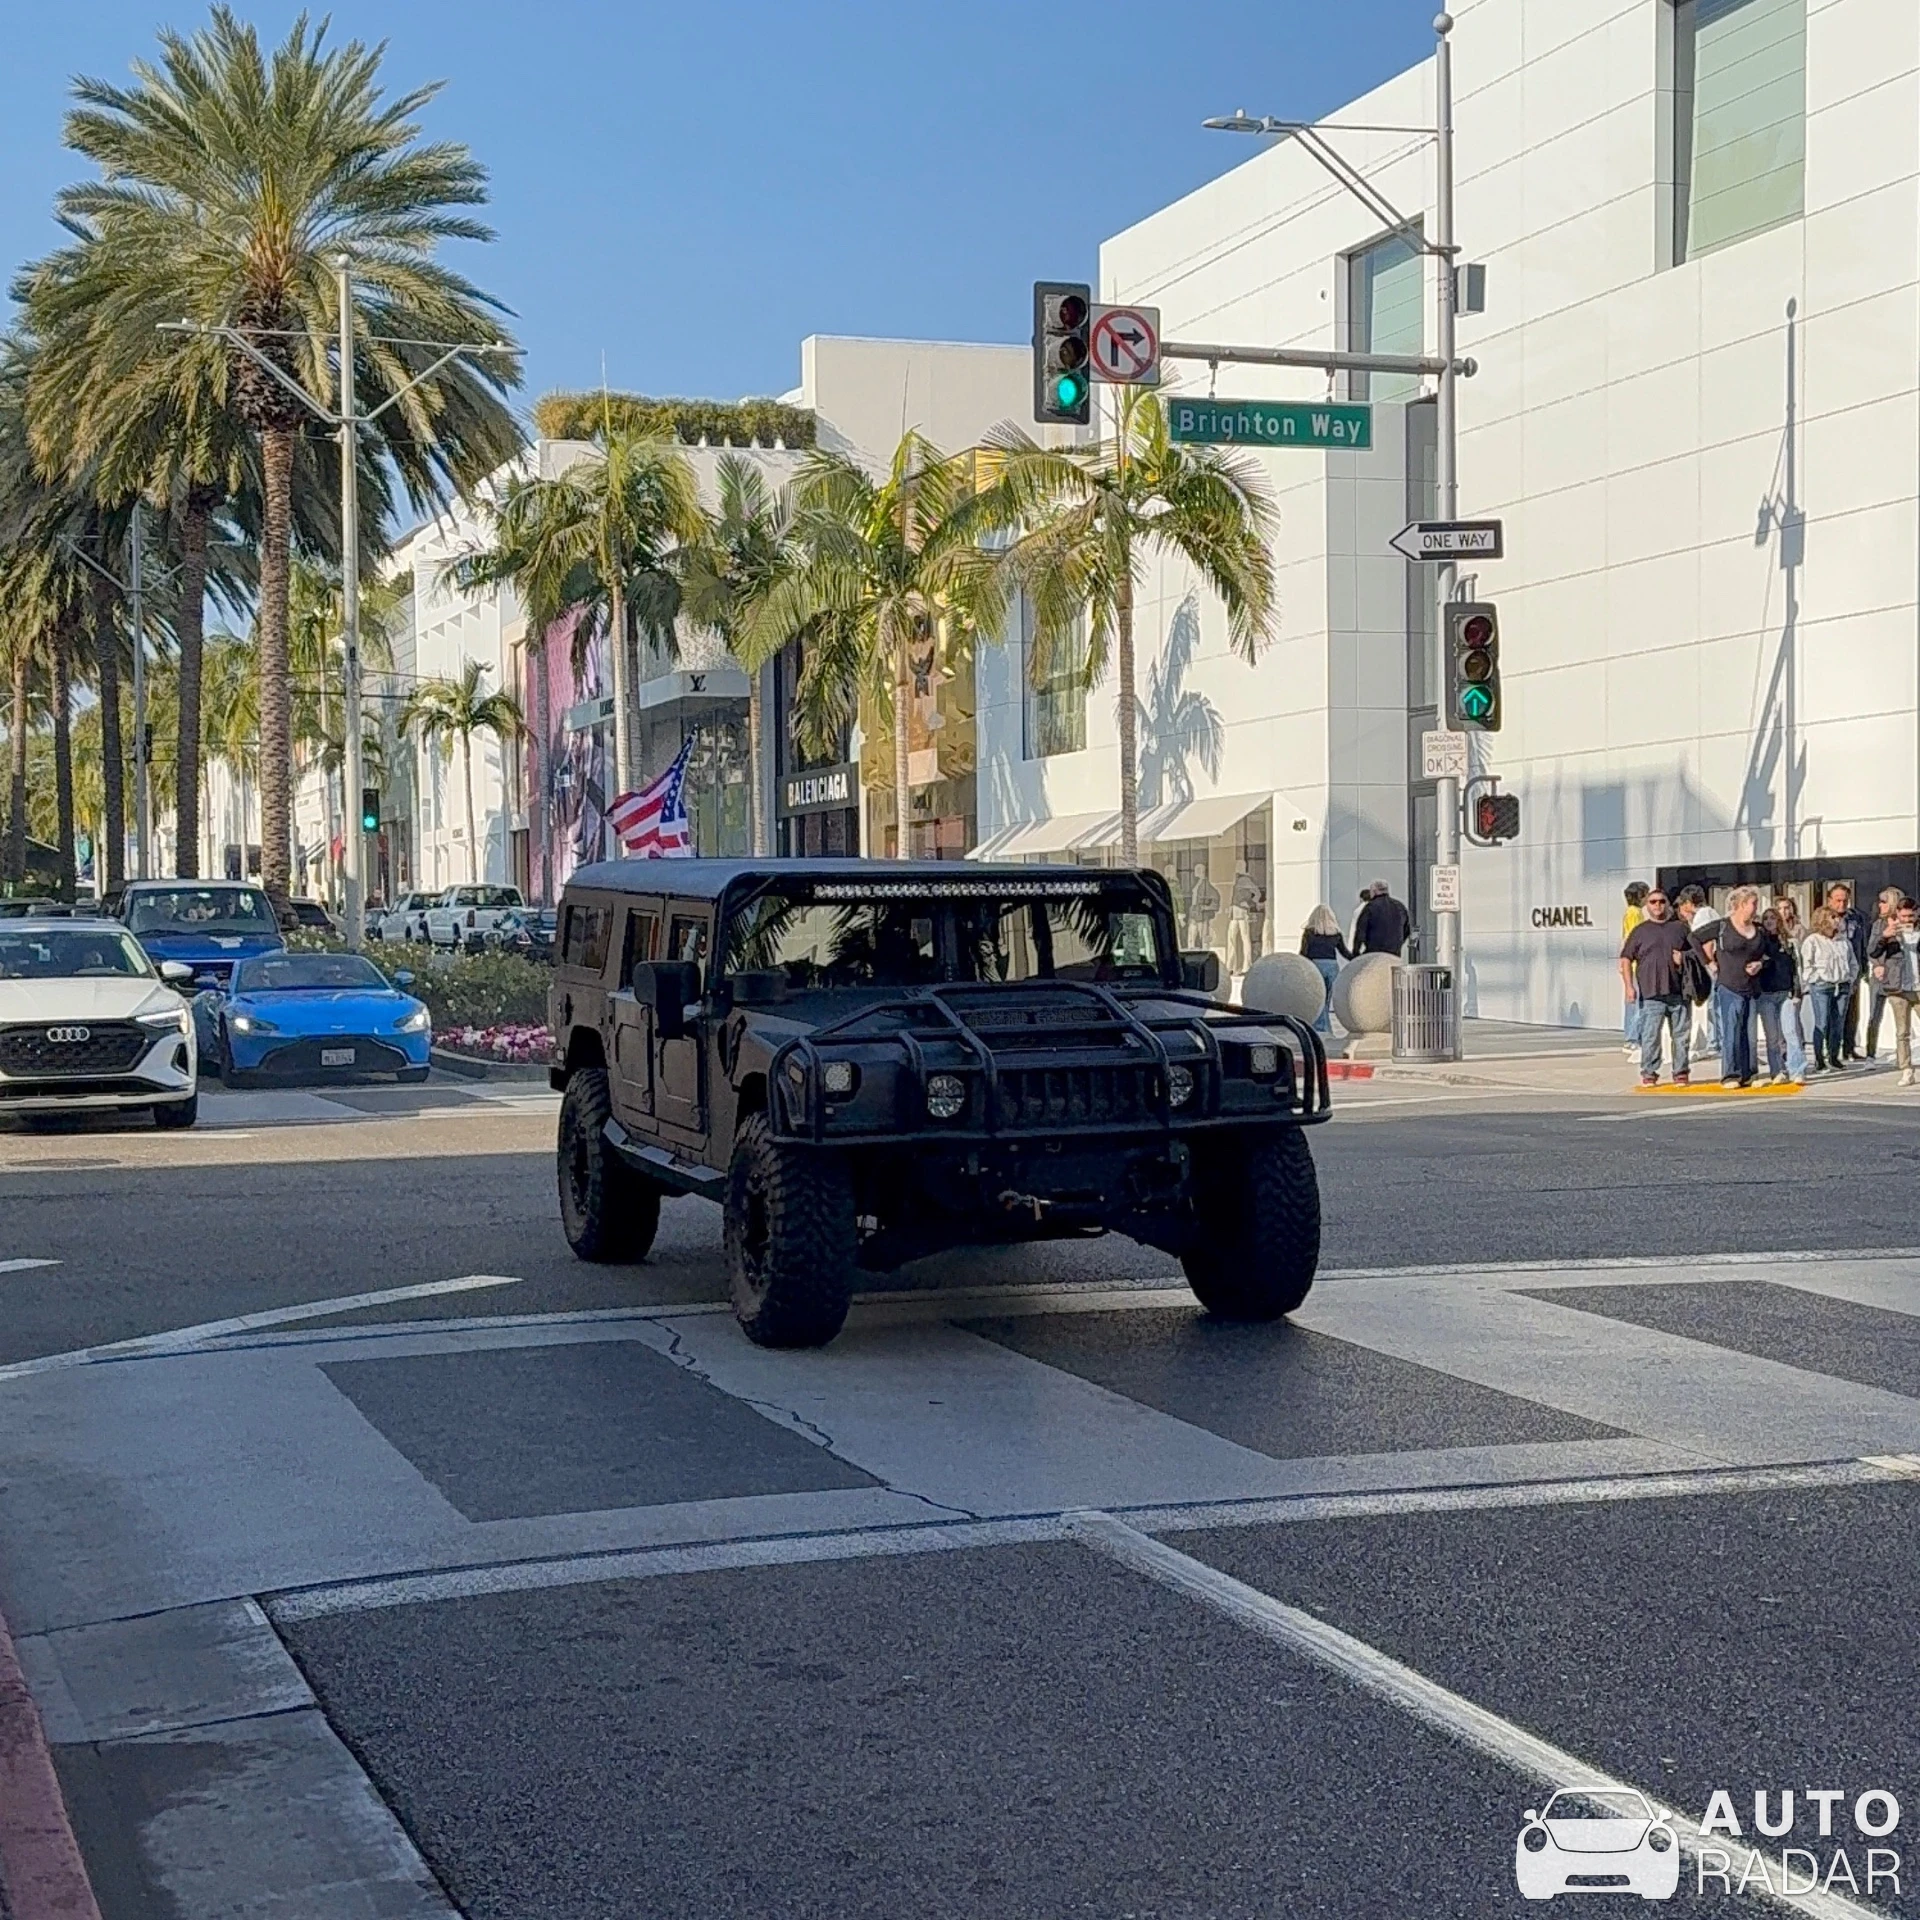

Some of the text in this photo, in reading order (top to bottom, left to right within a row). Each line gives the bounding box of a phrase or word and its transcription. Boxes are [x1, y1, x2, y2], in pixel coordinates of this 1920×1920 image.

[1179, 408, 1362, 443] Brighton Way
[1423, 532, 1488, 549] ONE WAY
[1426, 733, 1464, 743] DIAGONAL
[1427, 743, 1464, 752] CROSSING
[1427, 757, 1444, 772] OK
[787, 772, 848, 808] BALENCIAGA
[1531, 905, 1594, 928] CHANEL
